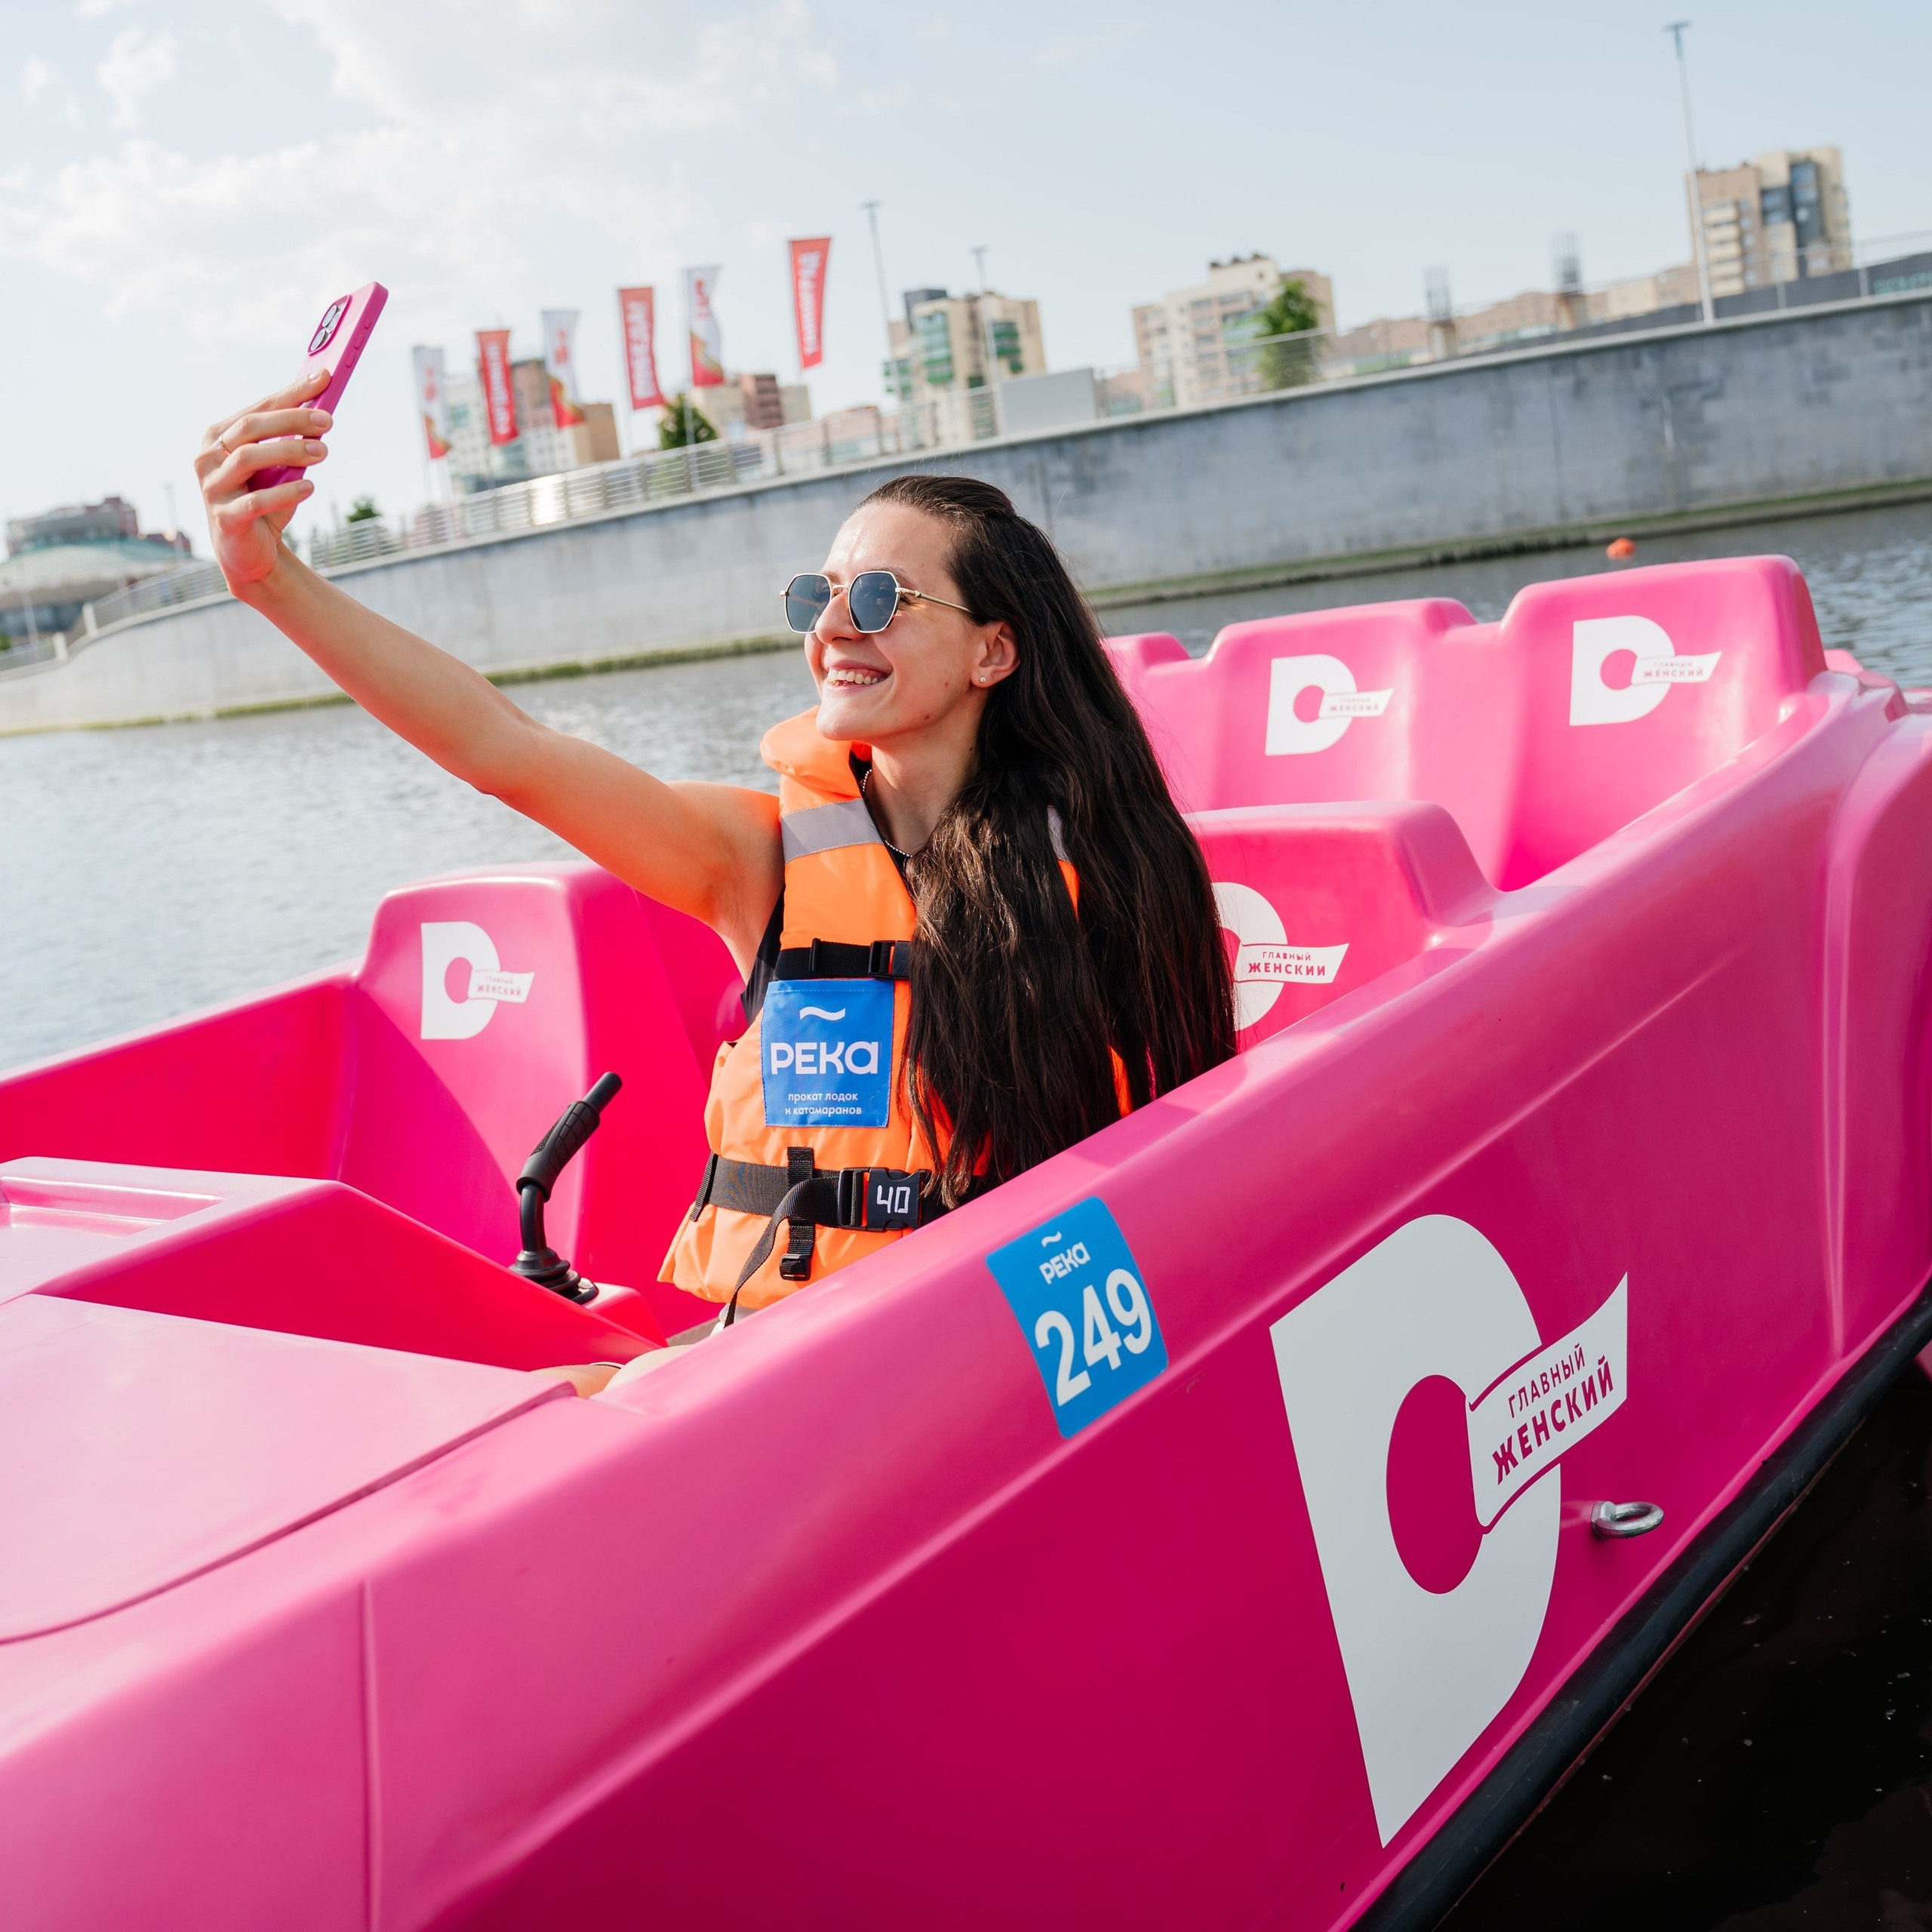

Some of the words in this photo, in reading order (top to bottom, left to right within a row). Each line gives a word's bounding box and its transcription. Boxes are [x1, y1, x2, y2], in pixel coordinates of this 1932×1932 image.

[1643, 667, 1703, 678] ЖЕНСКИЙ
[1262, 951, 1311, 961] ГЛАВНЫЙ
[788, 1093, 823, 1103] прокат
[825, 1093, 858, 1102] лодок
[793, 1106, 862, 1117] катамаранов
[876, 1185, 911, 1214] 40
[1035, 1268, 1152, 1407] 249
[1508, 1343, 1585, 1419] ГЛАВНЫЙ
[1492, 1355, 1614, 1486] ЖЕНСКИЙ
